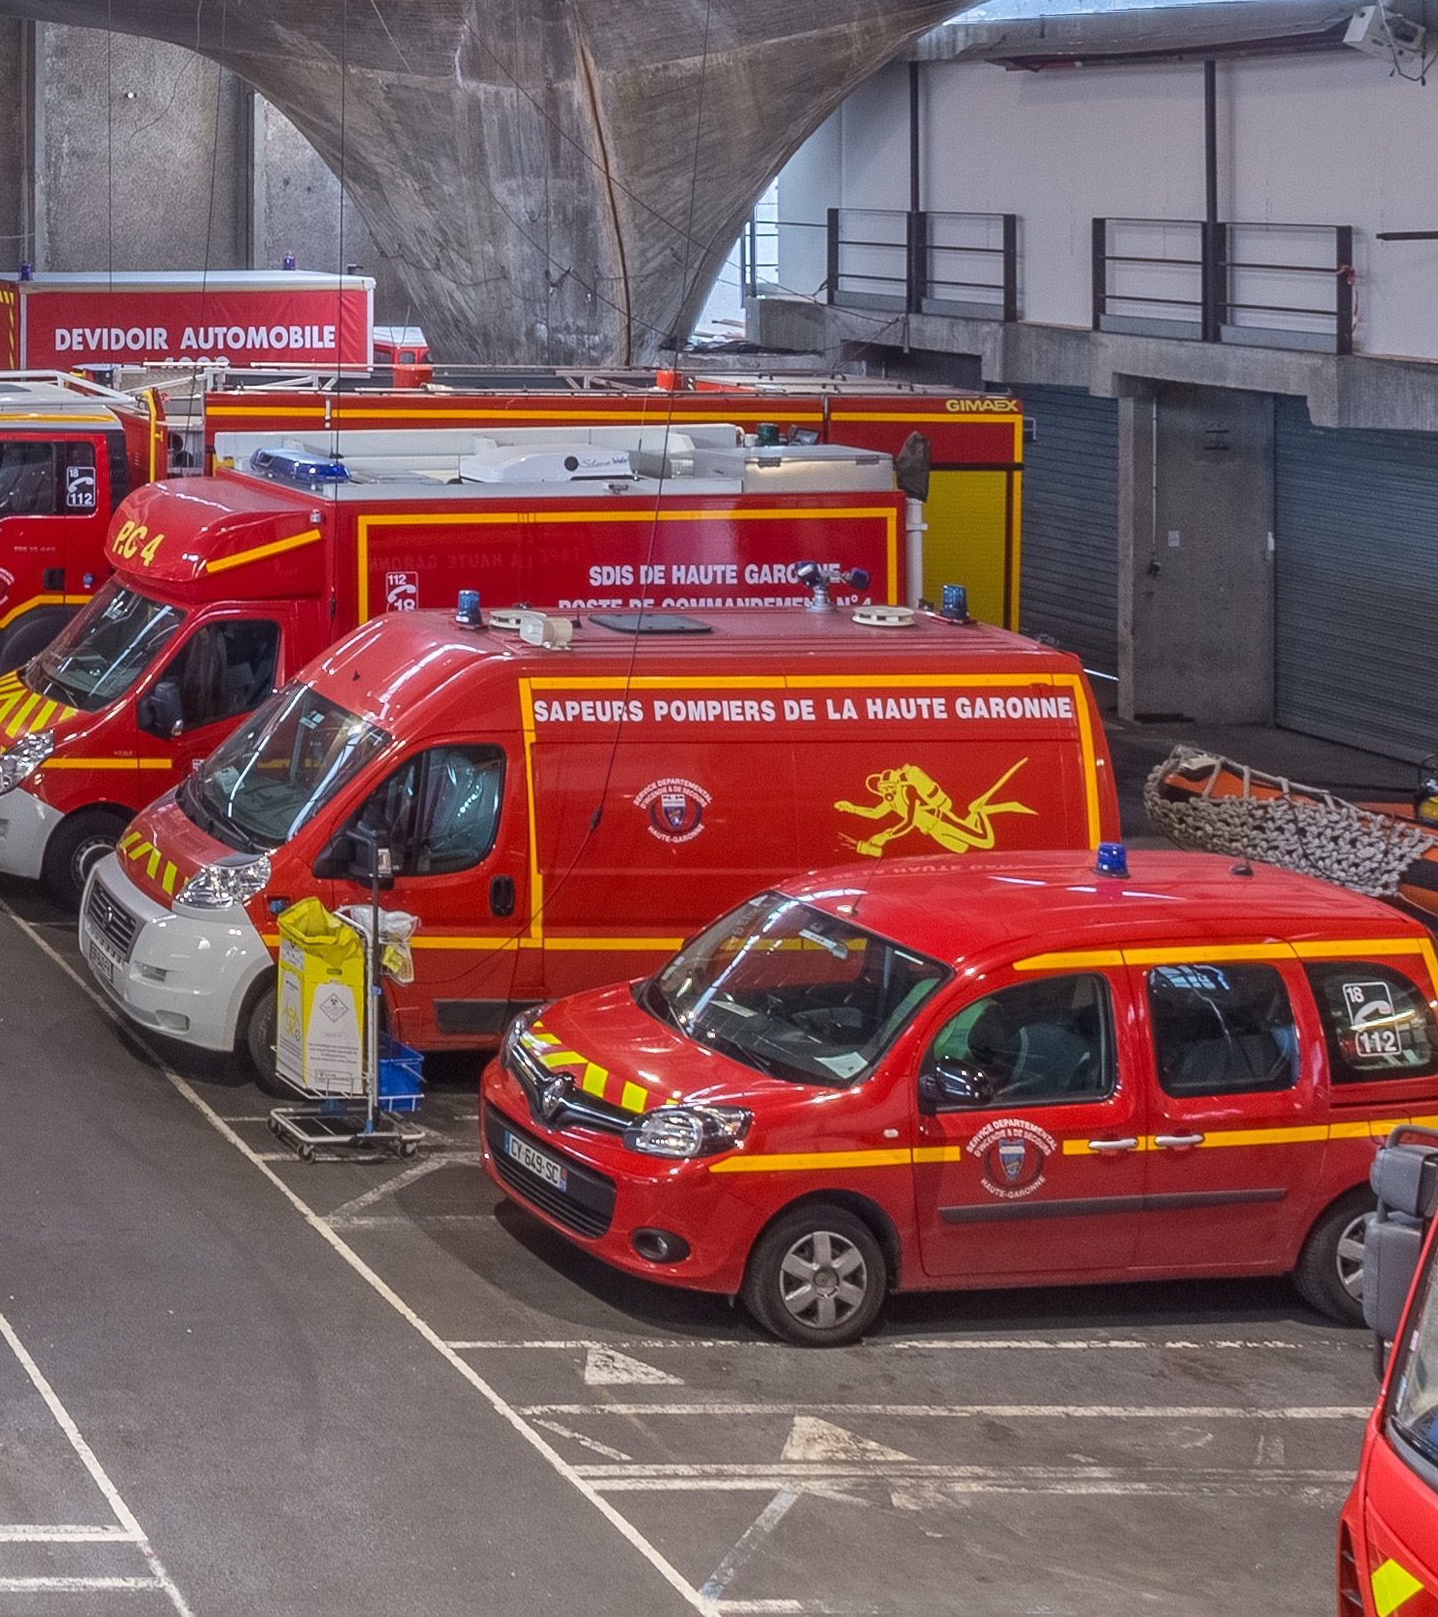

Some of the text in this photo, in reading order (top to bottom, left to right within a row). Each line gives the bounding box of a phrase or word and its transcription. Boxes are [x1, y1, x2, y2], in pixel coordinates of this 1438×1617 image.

[54, 325, 336, 351] DEVIDOIR AUTOMOBILE
[945, 399, 1019, 412] GIMAEX
[69, 468, 80, 478] 18
[70, 492, 93, 505] 112
[139, 533, 165, 567] 4
[388, 573, 407, 585] 112
[588, 564, 634, 586] SDIS
[639, 565, 666, 585] DE
[671, 563, 738, 584] HAUTE
[533, 696, 1074, 723] SAPEURS POMPIERS DE LA HAUTE GARONNE
[632, 782, 658, 806] SERVICE
[647, 822, 705, 844] HAUTE-GARONNE
[1345, 986, 1365, 1003] 18
[1358, 1029, 1397, 1053] 112
[965, 1122, 995, 1154] SERVICE
[1012, 1127, 1024, 1137] DE
[980, 1174, 1046, 1199] HAUTE-GARONNE
